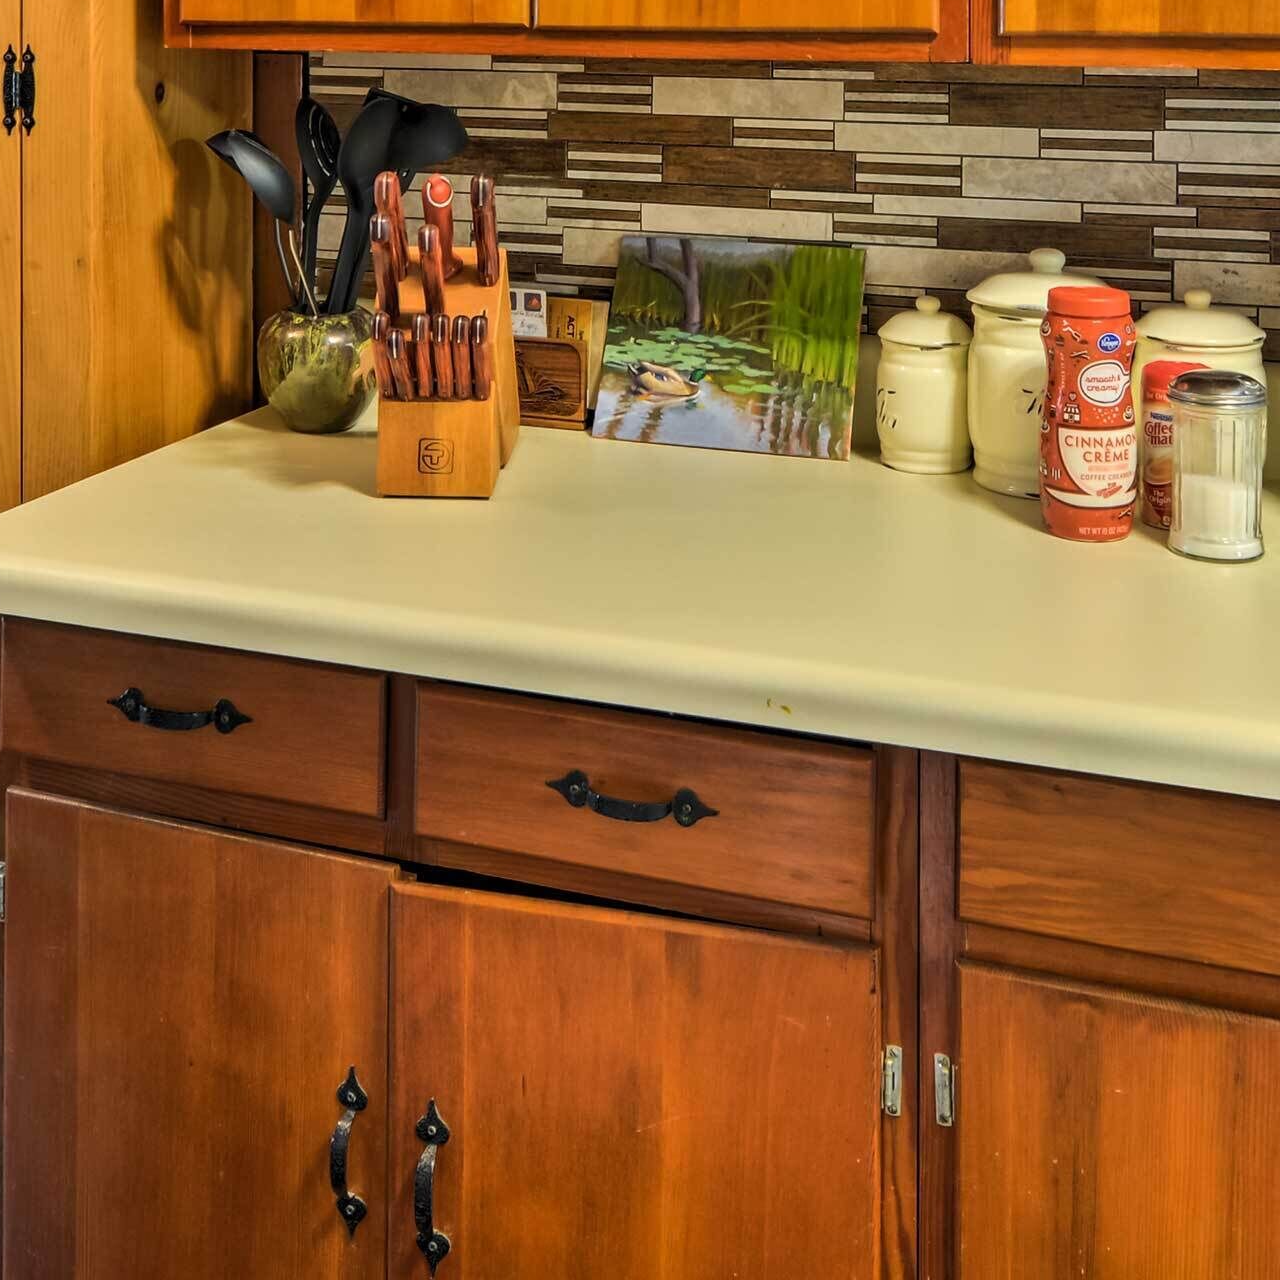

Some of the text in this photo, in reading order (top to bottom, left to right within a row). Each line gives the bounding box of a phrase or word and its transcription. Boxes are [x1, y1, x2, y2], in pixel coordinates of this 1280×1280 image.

[1086, 375, 1116, 383] smooth
[1151, 435, 1173, 445] mat
[1080, 473, 1106, 481] COFFEE
